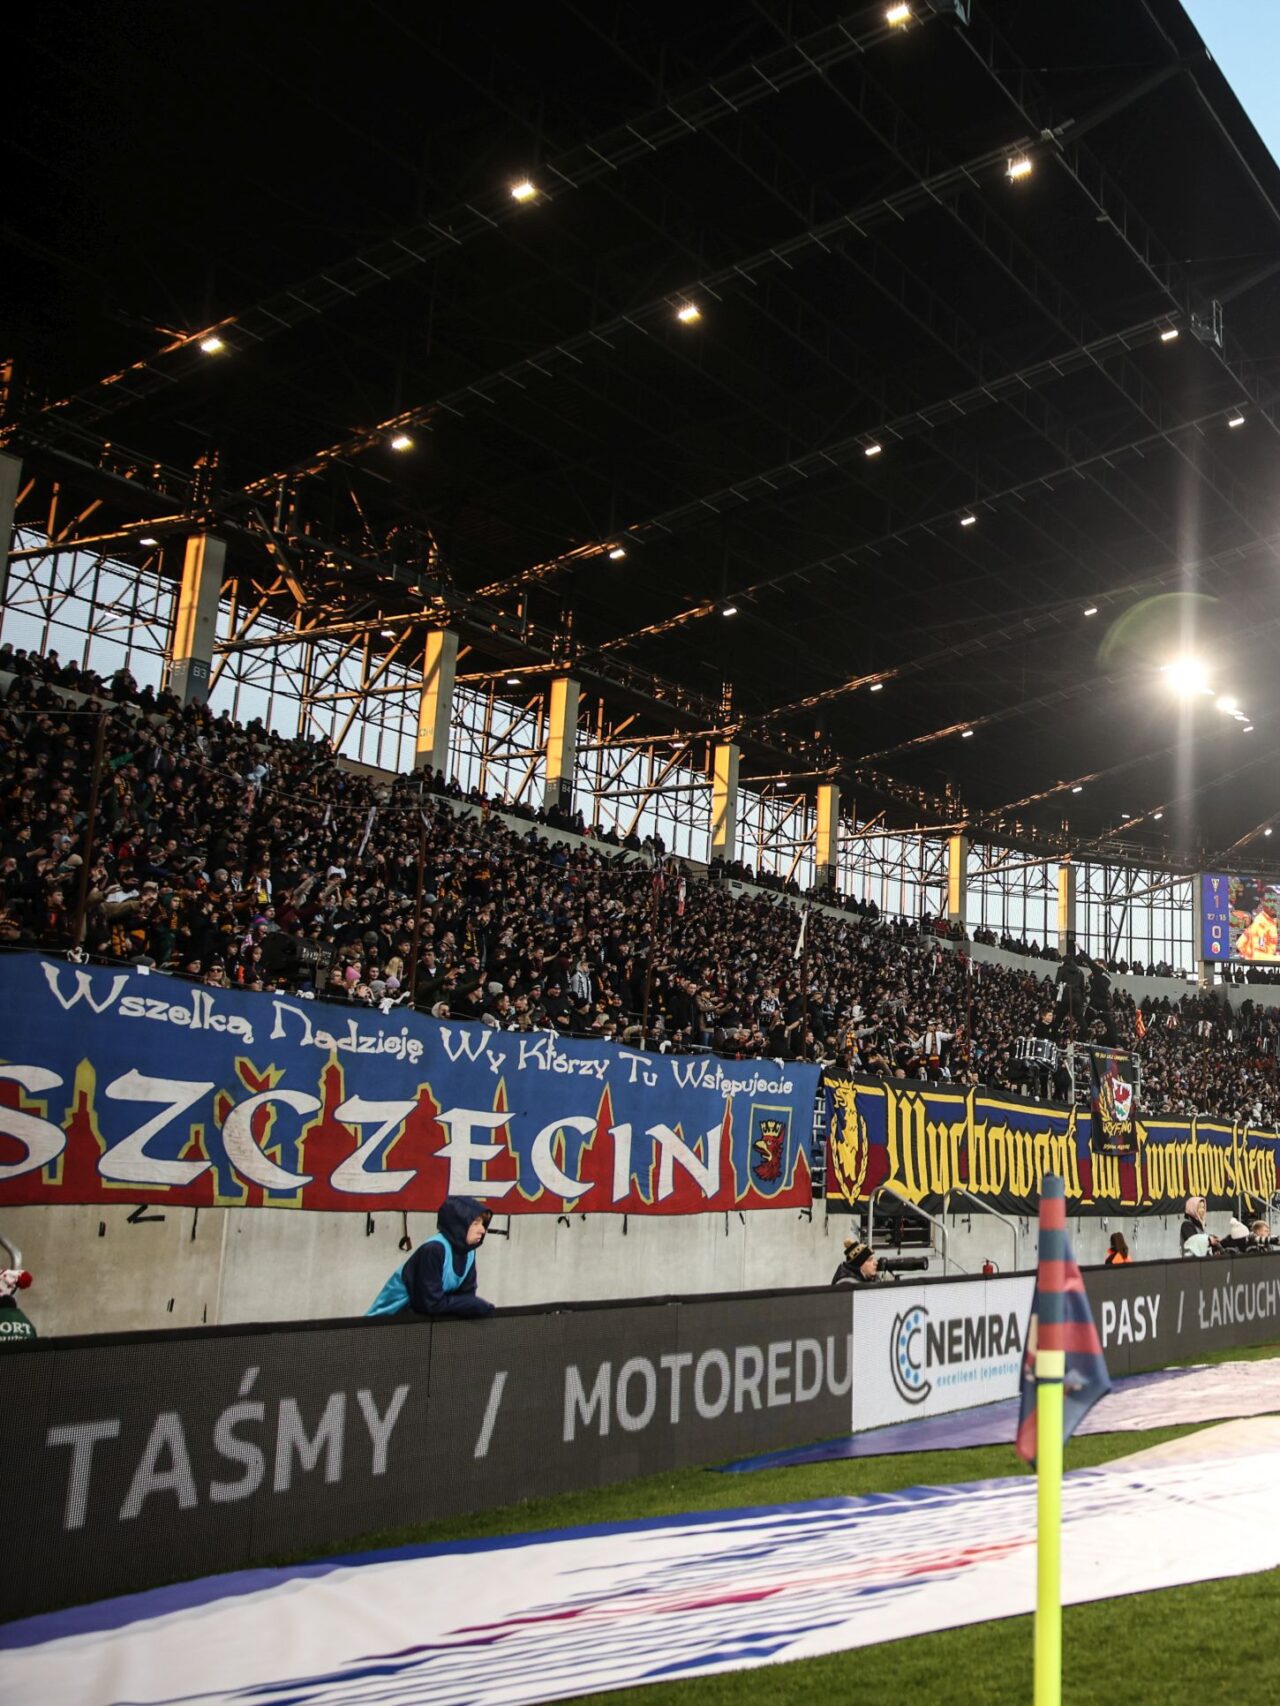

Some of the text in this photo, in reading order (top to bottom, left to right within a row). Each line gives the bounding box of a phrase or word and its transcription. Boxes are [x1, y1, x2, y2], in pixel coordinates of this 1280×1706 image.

[1214, 895, 1219, 908] 1
[1212, 925, 1221, 938] 0
[40, 961, 253, 1044] Wszelką
[439, 1027, 506, 1074] Wy
[518, 1037, 610, 1079] Którzy
[619, 1052, 657, 1086] Tu
[671, 1059, 793, 1098] Wstępujecie
[0, 1064, 723, 1199] SZCZECIN
[926, 1312, 1022, 1368] NEMRA
[1101, 1294, 1160, 1348] PASY
[936, 1366, 977, 1387] excellent
[46, 1366, 408, 1530] TAŚMY
[563, 1333, 853, 1442] MOTOREDU
